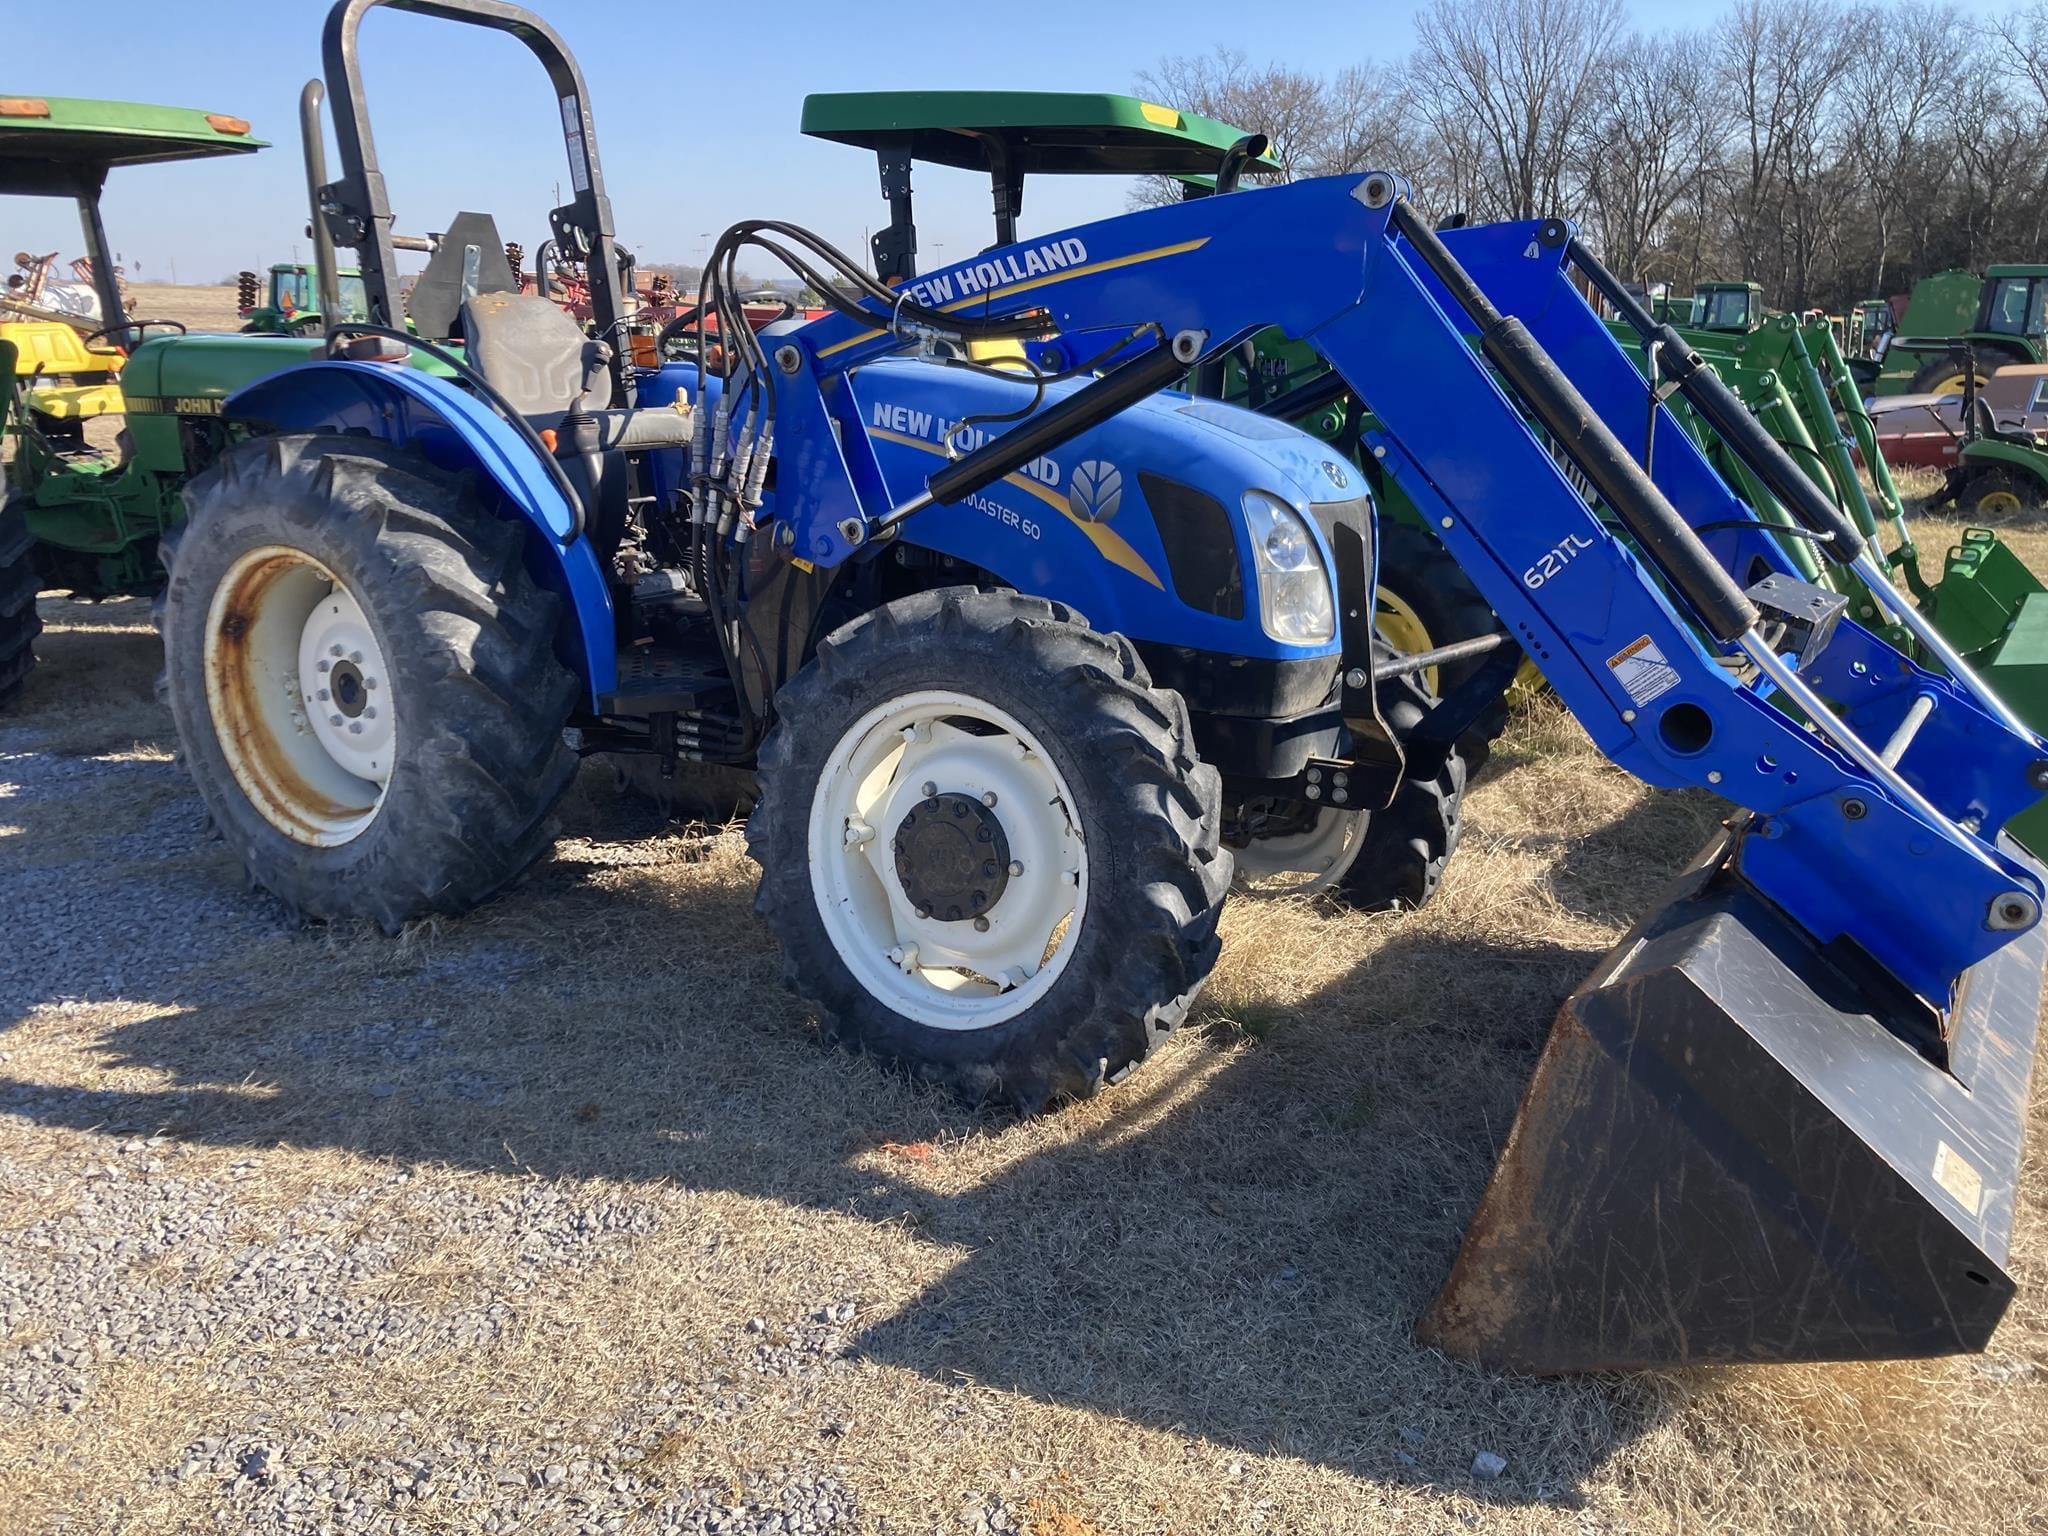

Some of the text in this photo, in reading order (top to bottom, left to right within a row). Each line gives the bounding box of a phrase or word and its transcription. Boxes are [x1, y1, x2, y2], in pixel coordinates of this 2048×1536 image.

[955, 238, 1088, 295] HOLLAND
[175, 398, 211, 413] JOHN
[873, 402, 932, 438] NEW
[1022, 519, 1041, 540] 60
[1523, 533, 1593, 590] 621TL
